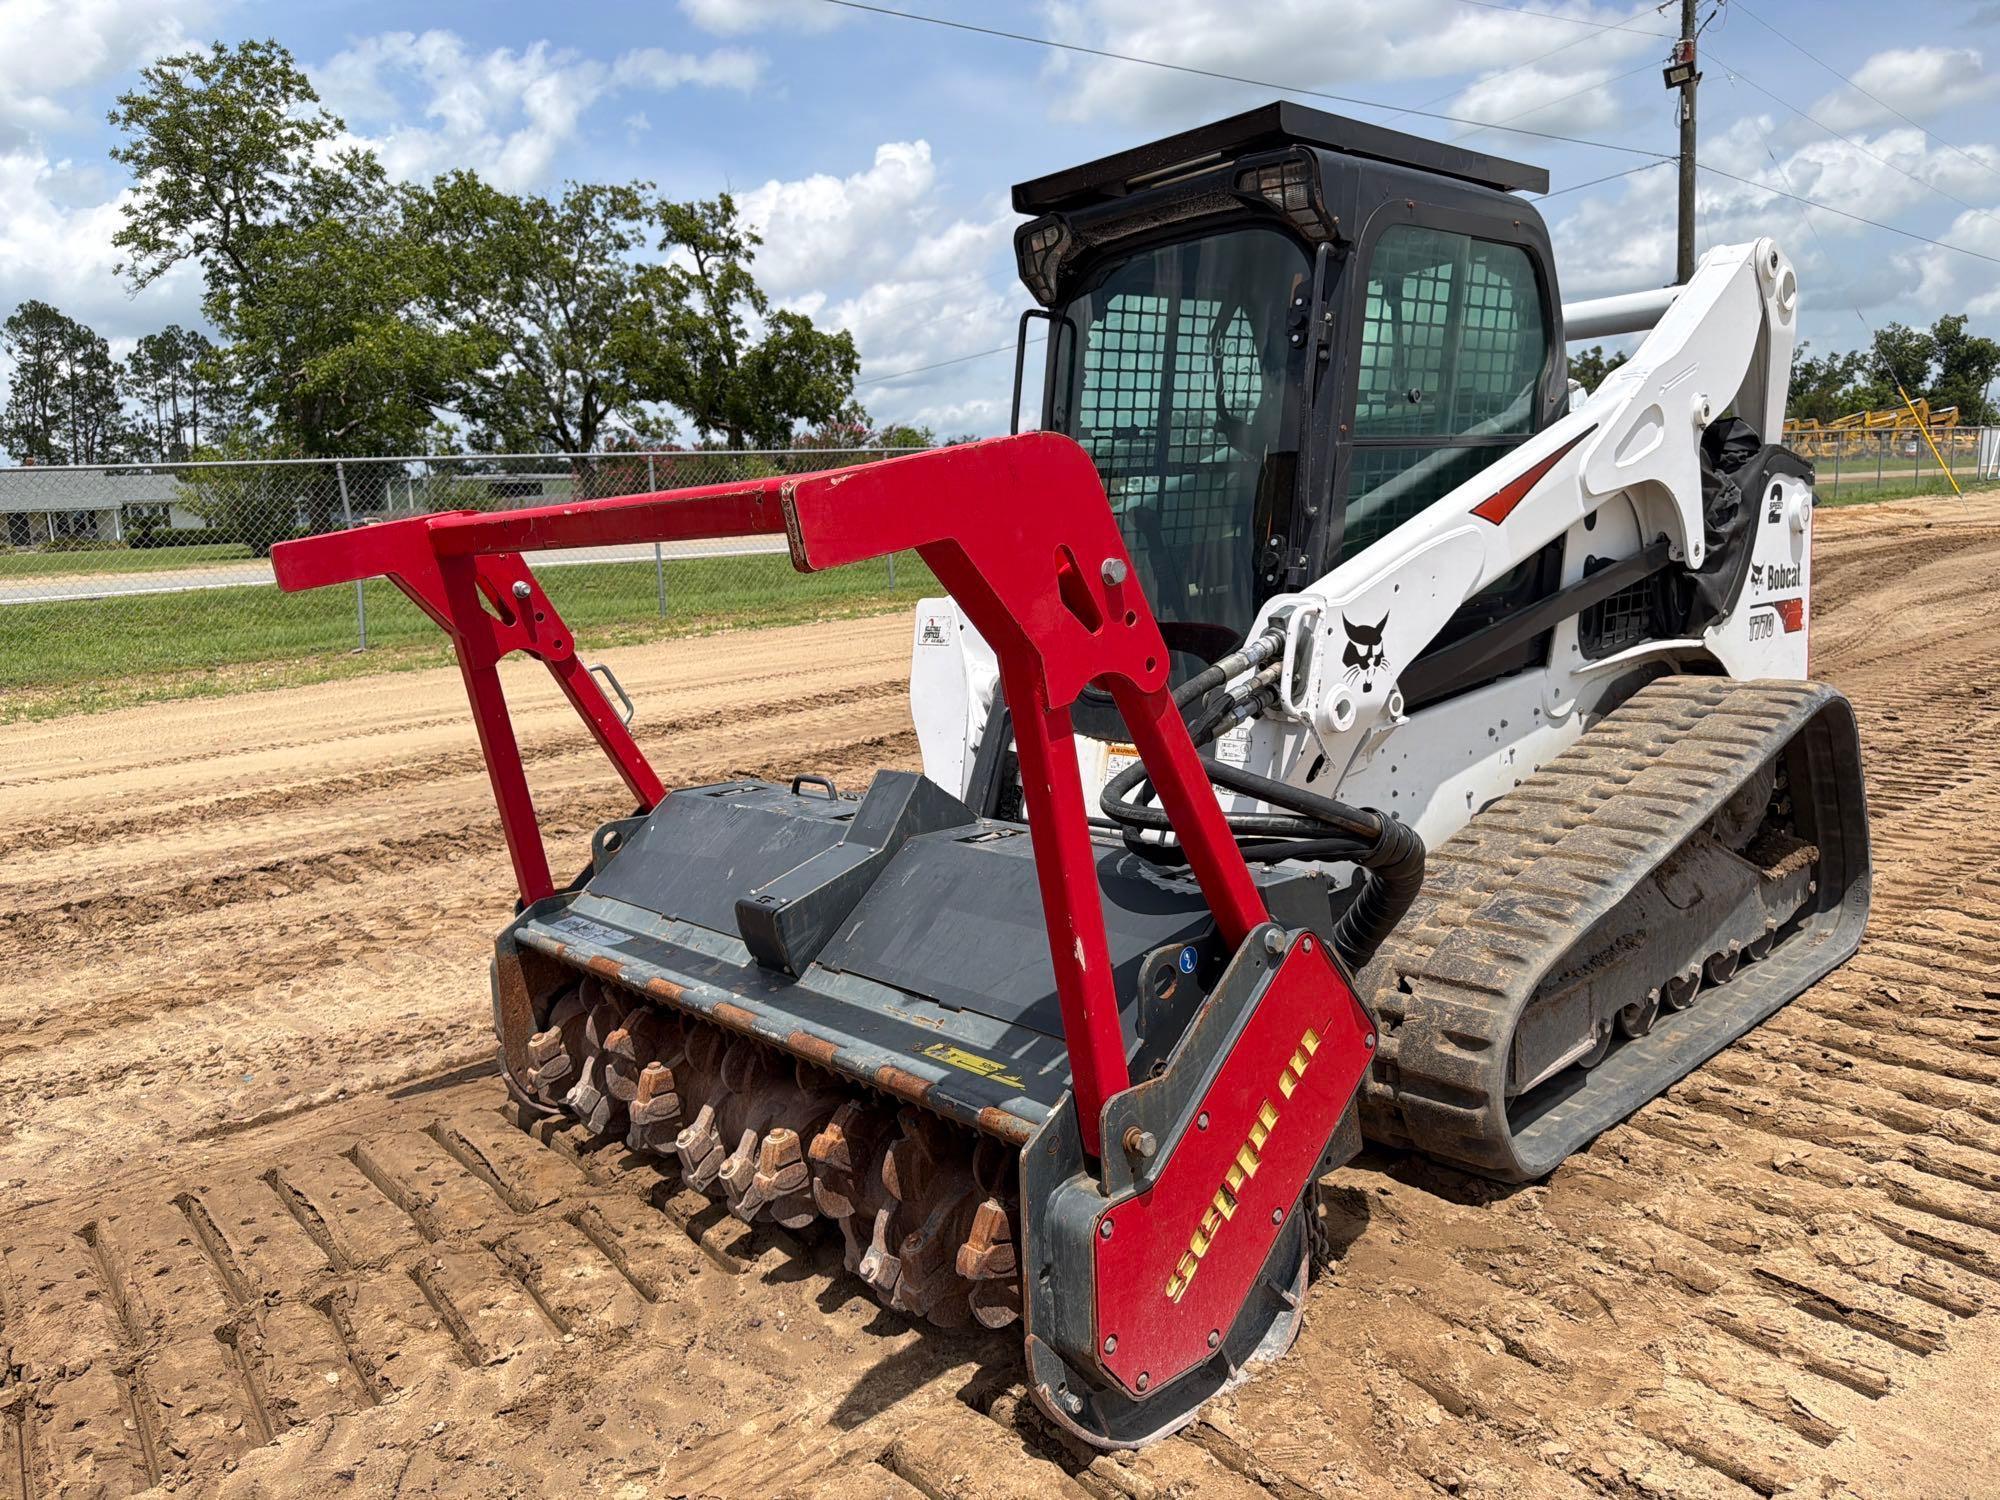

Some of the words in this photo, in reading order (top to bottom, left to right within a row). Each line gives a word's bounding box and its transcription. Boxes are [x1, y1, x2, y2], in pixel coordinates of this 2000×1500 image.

[1768, 483, 1782, 524] 2
[1769, 502, 1783, 510] SPEED
[1767, 563, 1801, 591] Bobcat
[1749, 613, 1774, 641] T770
